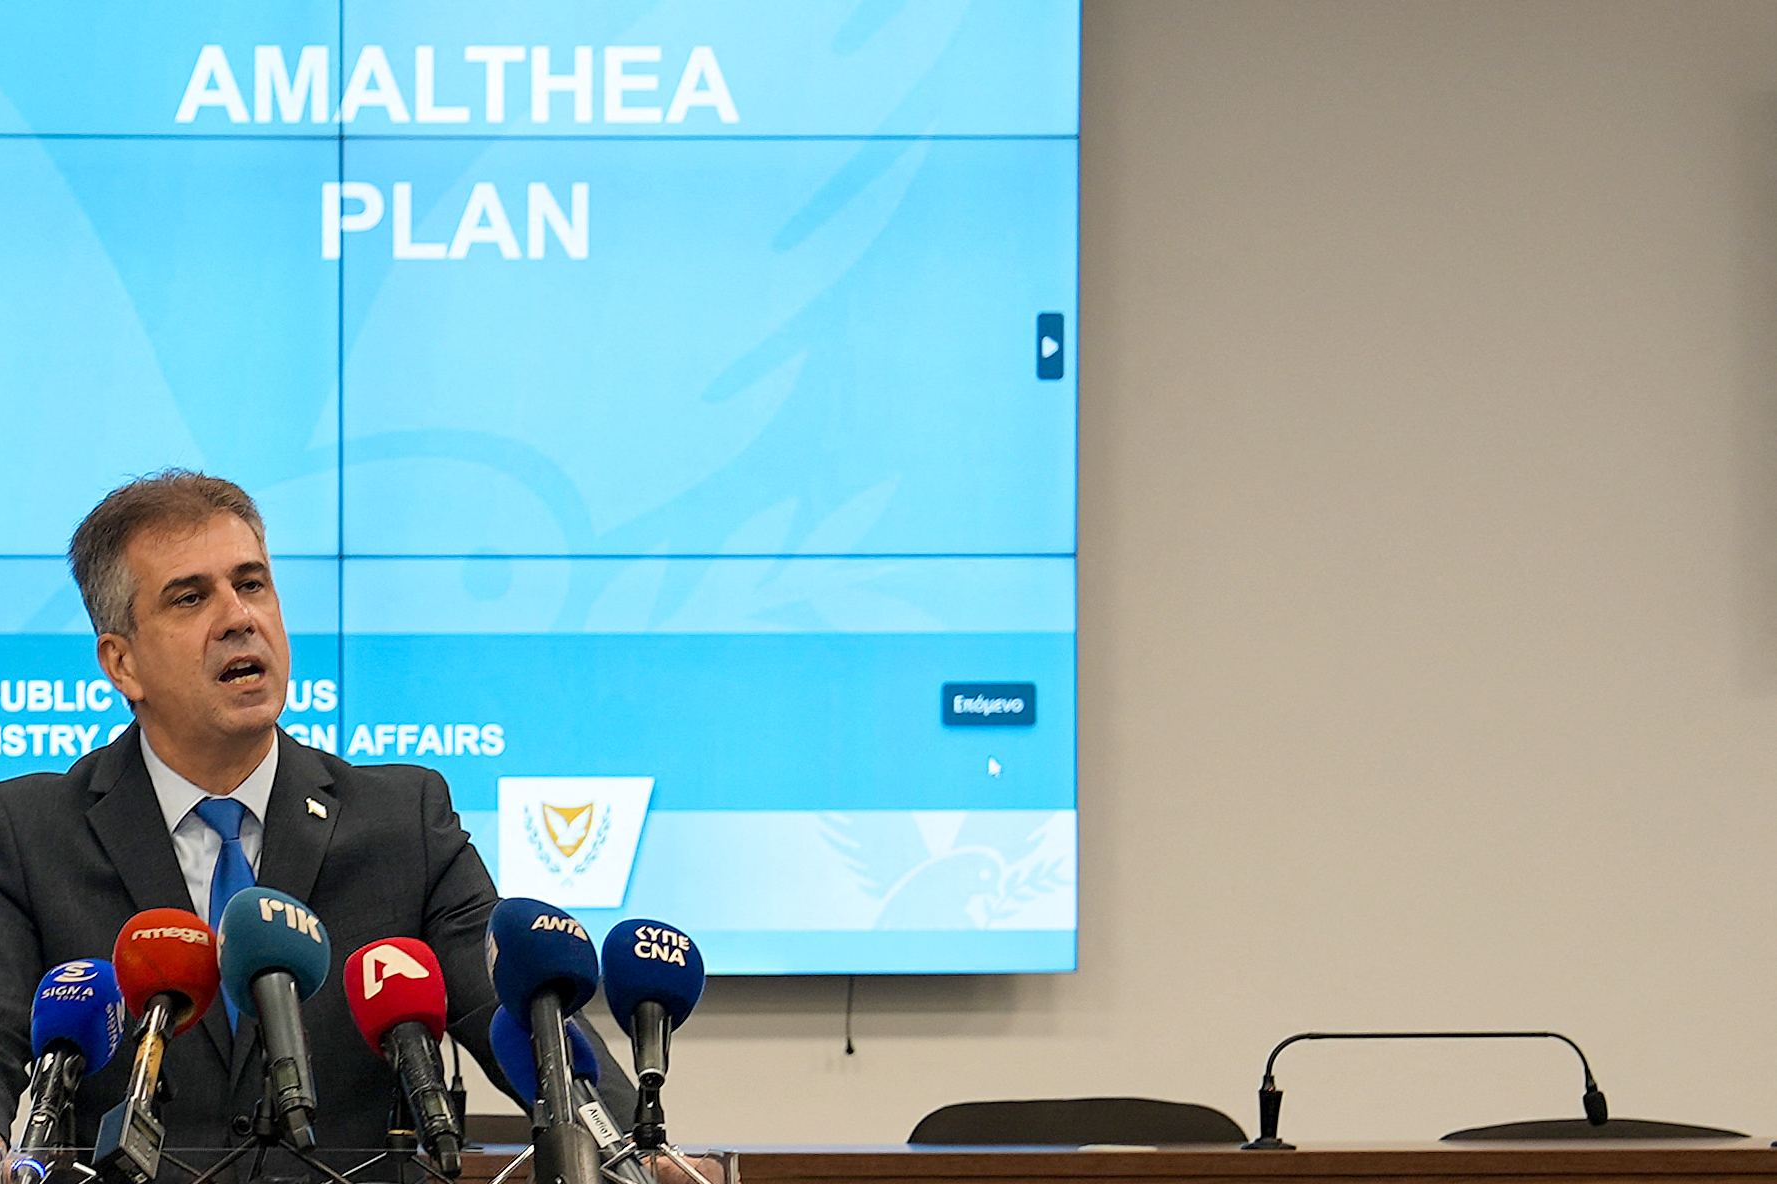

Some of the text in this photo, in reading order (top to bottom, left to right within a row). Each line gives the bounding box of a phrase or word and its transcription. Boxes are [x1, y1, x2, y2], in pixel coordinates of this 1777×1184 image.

[175, 44, 740, 124] AMALTHEA
[321, 181, 590, 260] PLAN
[346, 722, 506, 757] AFFAIRS
[633, 941, 687, 968] CNA
[40, 985, 94, 1000] SIGMA
